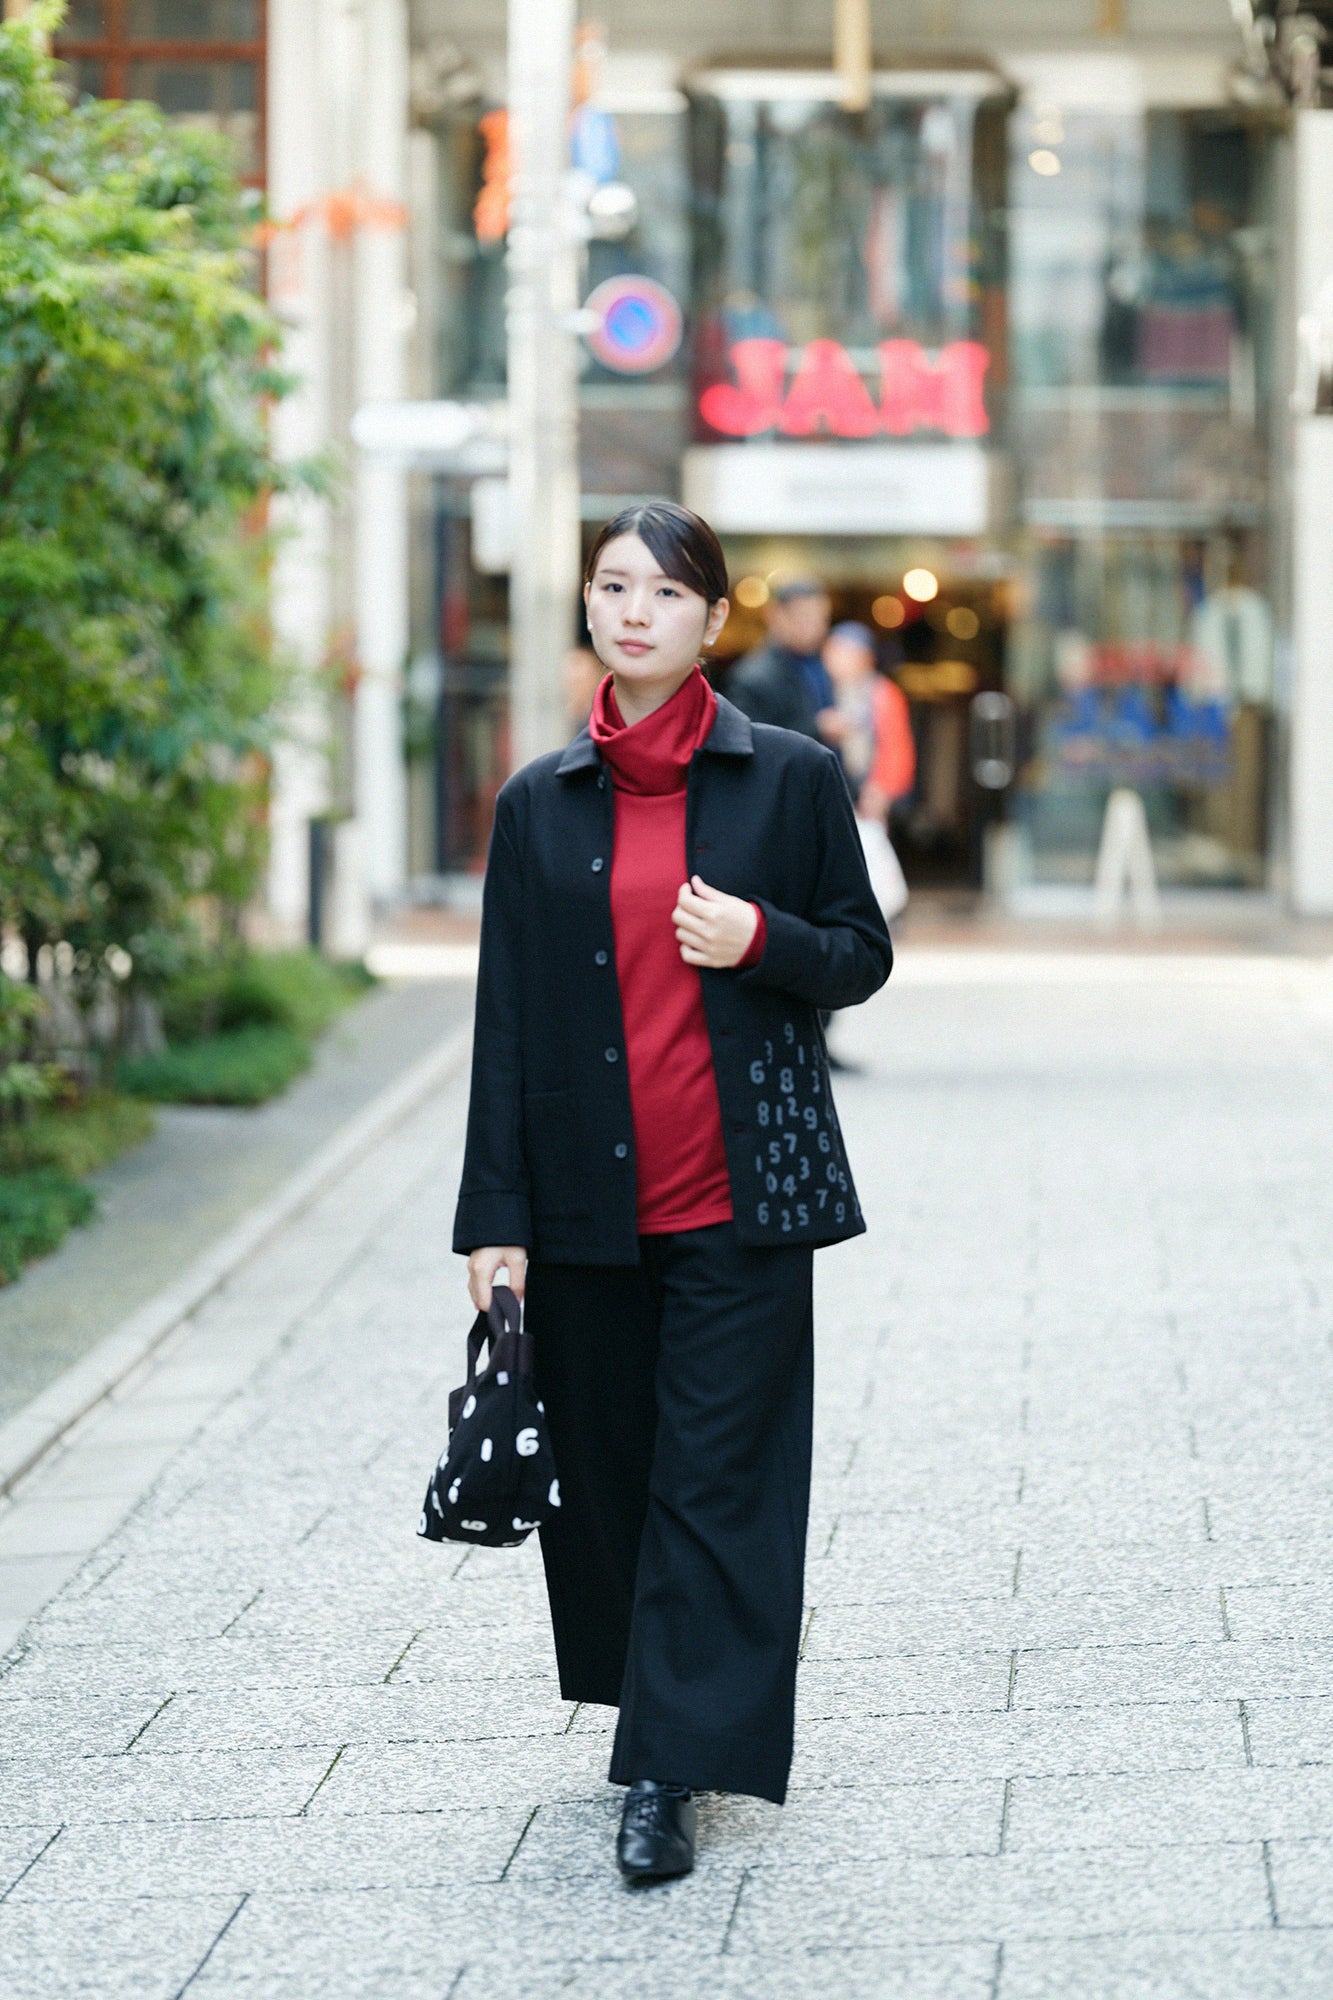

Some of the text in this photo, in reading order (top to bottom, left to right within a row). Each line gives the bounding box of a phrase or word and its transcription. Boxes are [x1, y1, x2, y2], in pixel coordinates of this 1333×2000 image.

[699, 338, 990, 437] JAM
[784, 1023, 794, 1044] 9
[750, 1060, 765, 1084] 6
[780, 1068, 795, 1093] 8
[757, 1101, 770, 1126] 8
[775, 1105, 783, 1125] 1
[787, 1096, 799, 1117] 2
[803, 1106, 818, 1130] 9
[769, 1141, 781, 1164] 5
[784, 1132, 797, 1154] 7
[818, 1131, 831, 1153] 6
[756, 1155, 762, 1173] 1
[800, 1156, 810, 1180] 3
[826, 1161, 838, 1183] 0
[766, 1171, 778, 1194] 0
[782, 1174, 797, 1197] 4
[838, 1170, 848, 1192] 5
[816, 1189, 828, 1209] 7
[757, 1202, 769, 1224] 6
[781, 1209, 792, 1232] 2
[796, 1203, 809, 1226] 5
[835, 1202, 845, 1223] 9
[516, 1427, 540, 1457] 6
